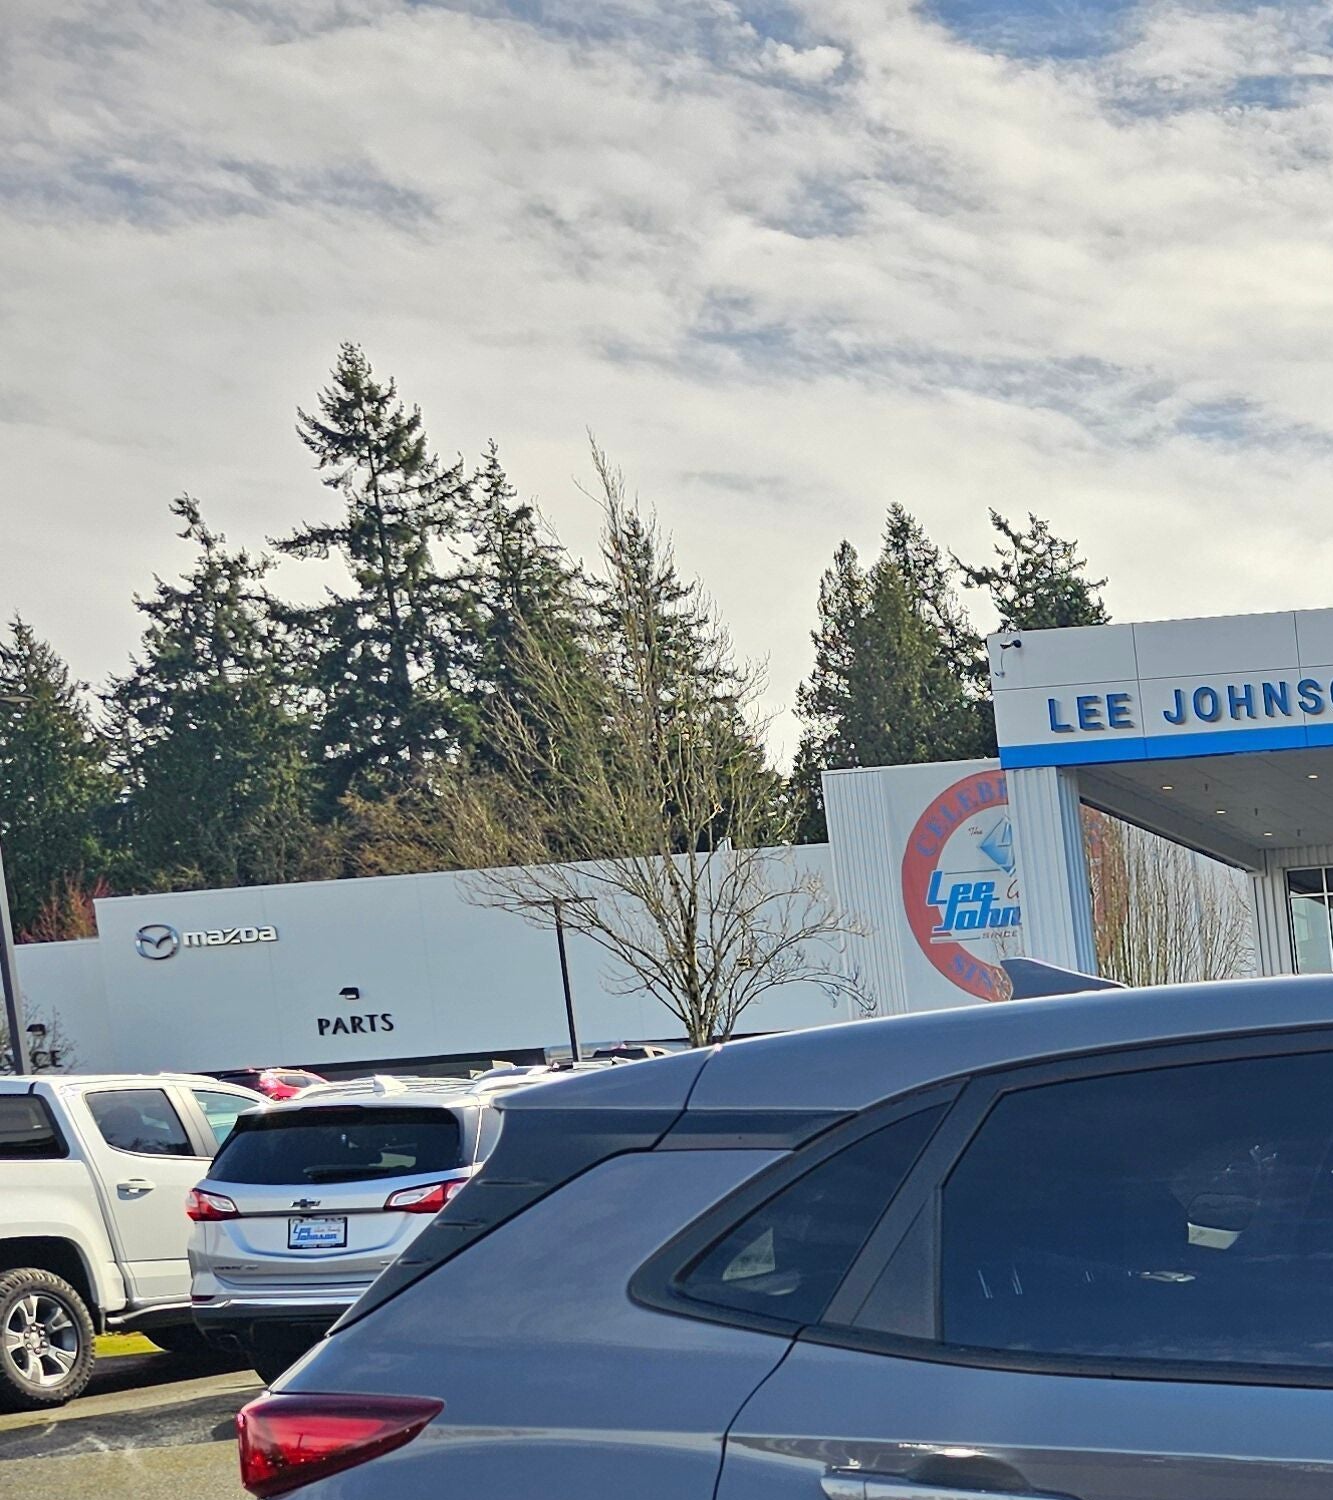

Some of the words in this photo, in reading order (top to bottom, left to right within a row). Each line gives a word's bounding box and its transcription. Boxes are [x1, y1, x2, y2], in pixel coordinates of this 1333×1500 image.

[1048, 693, 1135, 733] LEE
[927, 871, 999, 905] Lee
[317, 1013, 394, 1036] PARTS
